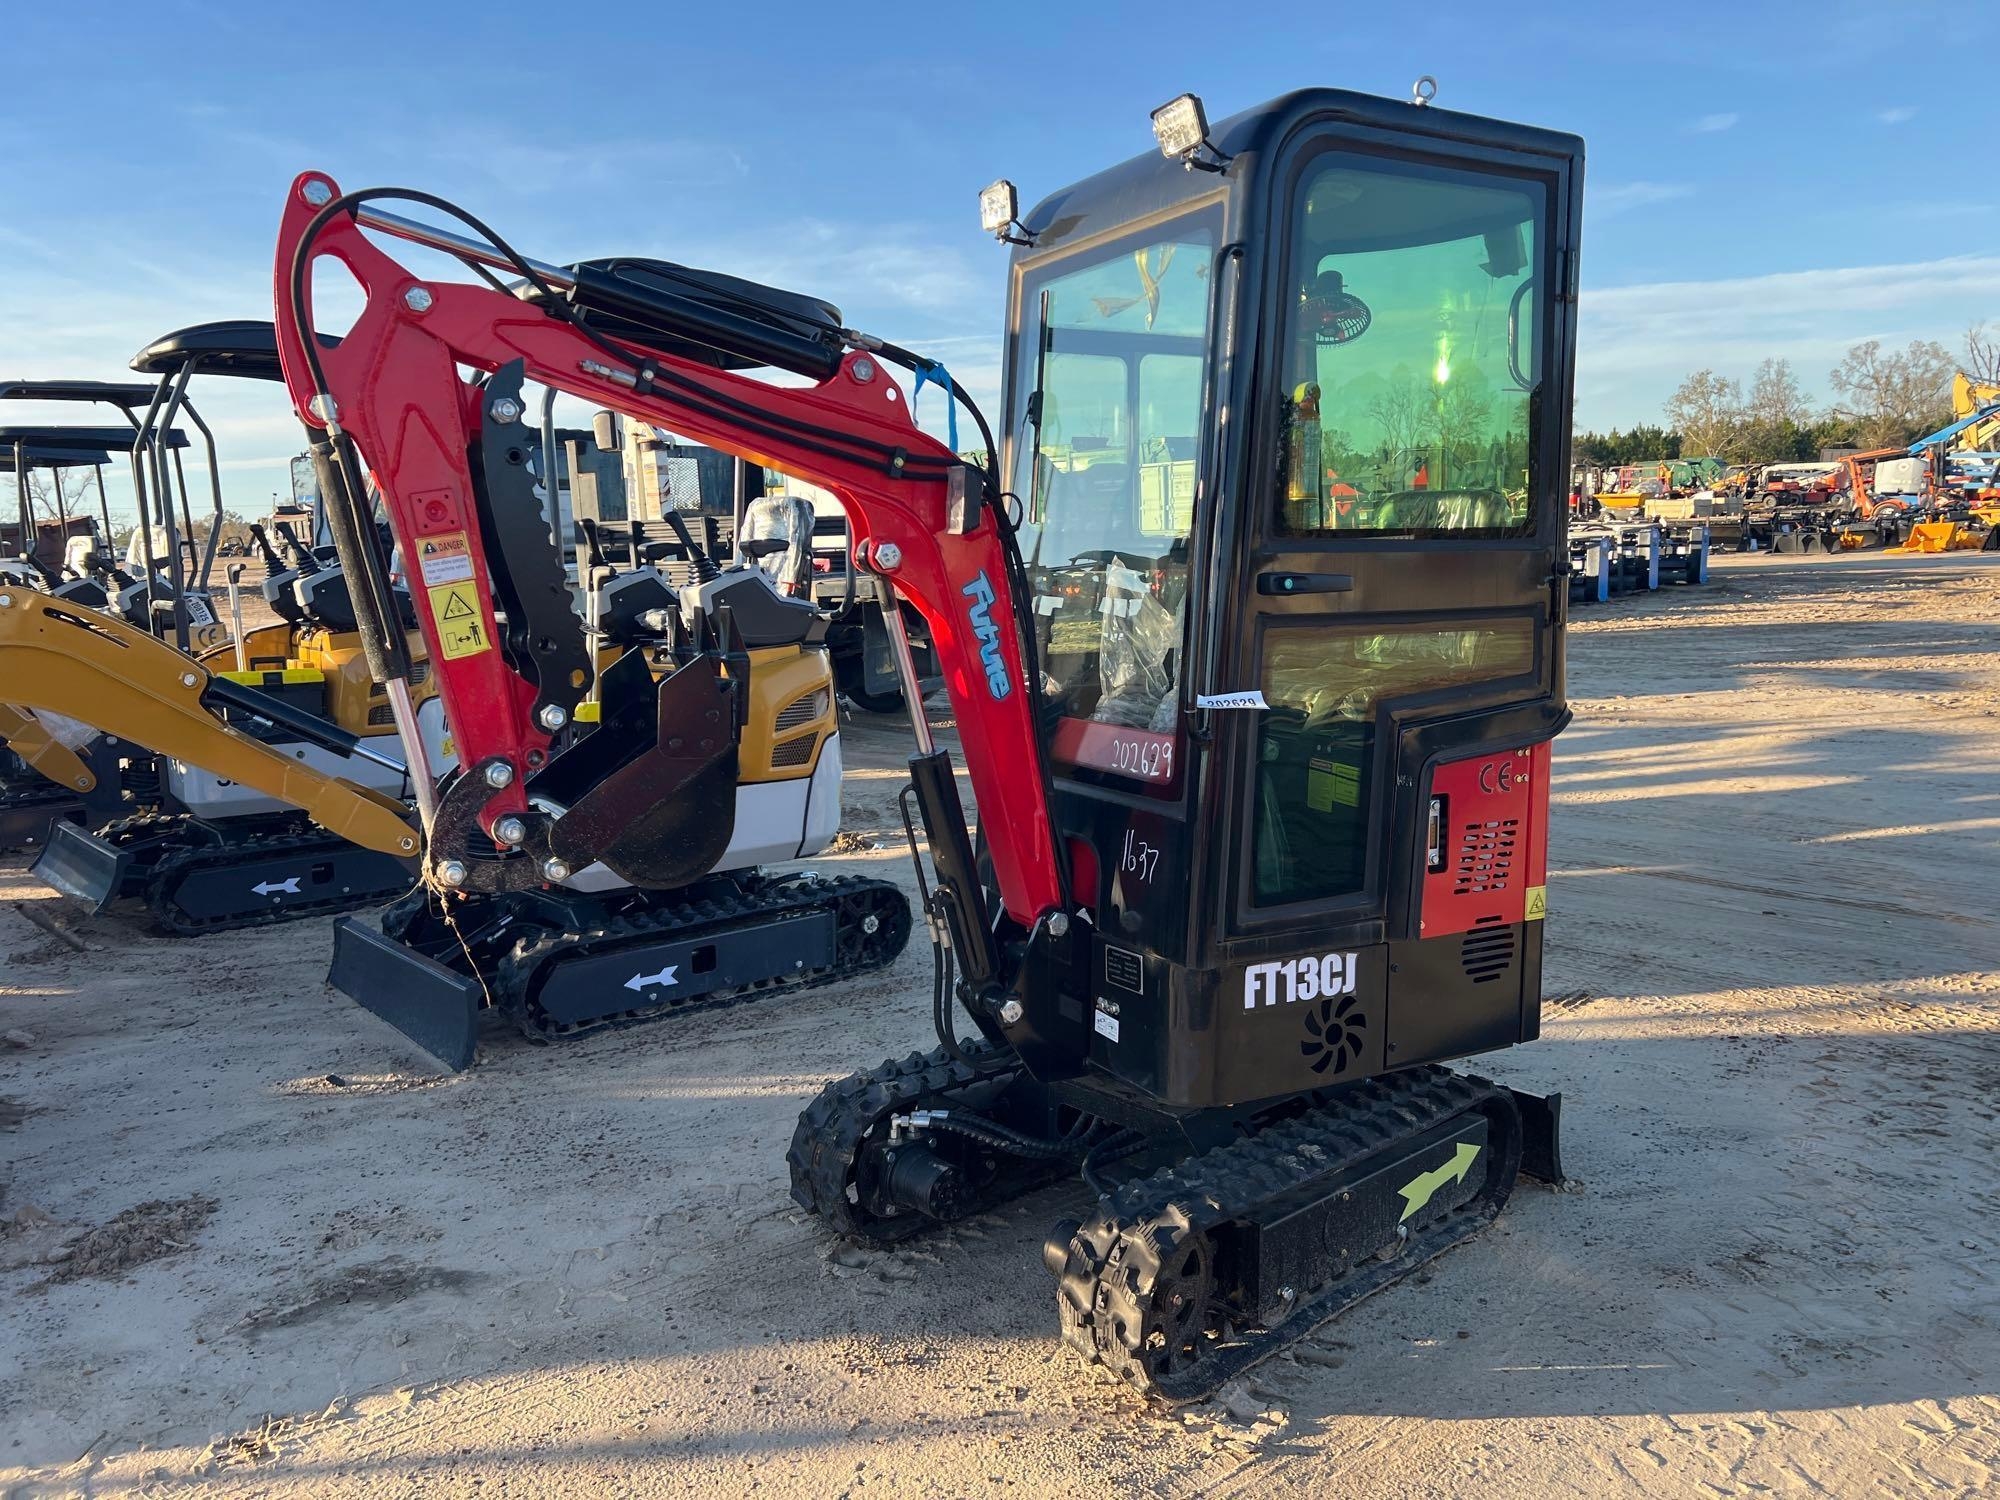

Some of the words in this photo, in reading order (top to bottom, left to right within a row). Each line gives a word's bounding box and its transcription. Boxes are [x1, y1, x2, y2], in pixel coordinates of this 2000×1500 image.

[438, 540, 465, 552] DANGER
[1111, 740, 1172, 778] 202629
[1479, 761, 1512, 794] CE
[1121, 829, 1159, 884] 1637
[1244, 953, 1358, 1009] FT13CJ
